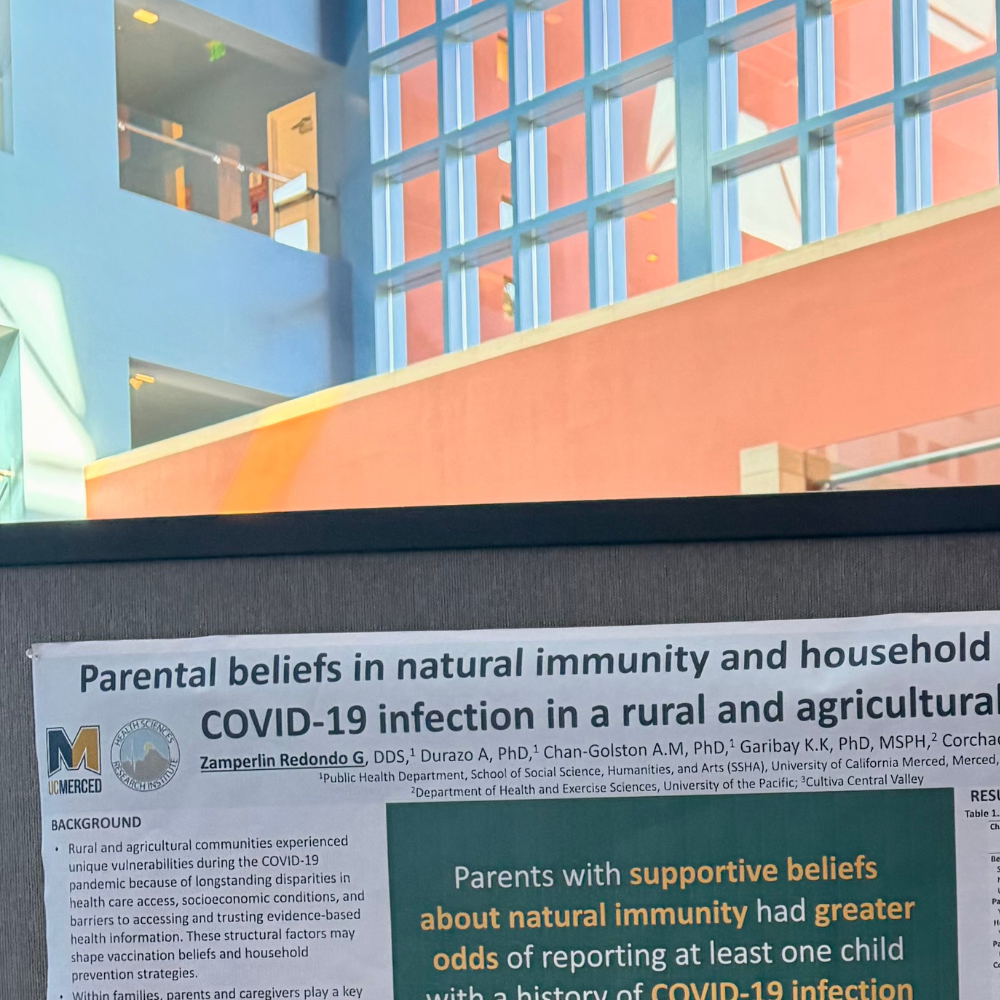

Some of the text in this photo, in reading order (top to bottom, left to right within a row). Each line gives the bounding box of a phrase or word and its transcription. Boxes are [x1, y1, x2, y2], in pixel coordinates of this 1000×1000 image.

[80, 656, 217, 693] Parental
[229, 652, 342, 687] beliefs
[354, 652, 384, 682] in
[397, 647, 524, 681] natural
[536, 643, 710, 679] immunity
[720, 639, 787, 671] and
[800, 630, 990, 669] household
[201, 704, 367, 740] COVID-19
[379, 700, 534, 734] infection
[547, 698, 578, 729] in
[590, 704, 609, 728] a
[622, 692, 705, 727] rural
[718, 690, 784, 724] and
[115, 719, 175, 748] HEALTH SCIENCES
[200, 753, 276, 772] Zamperlin
[280, 751, 349, 767] Redondo
[352, 751, 370, 768] G,
[421, 749, 474, 763] Durazo
[478, 747, 493, 764] A,
[543, 742, 647, 759] Chan-Golston
[652, 741, 689, 758] A.M,
[740, 738, 800, 756] Garibay
[804, 737, 833, 754] K.K,
[839, 735, 874, 753] PhD,
[113, 759, 179, 791] RESEARCH INSTITUTE
[51, 816, 142, 831] BACKGROUND
[964, 809, 989, 818] Table
[991, 809, 1000, 818] 1.
[68, 834, 349, 855] Rural and agricultural communities experienced
[68, 854, 319, 874] unique vulnerabilities during the COVID-19
[455, 854, 878, 891] Parents with supportive beliefs
[420, 897, 916, 931] about natural immunity had greater
[433, 935, 904, 974] odds of reporting at least one child
